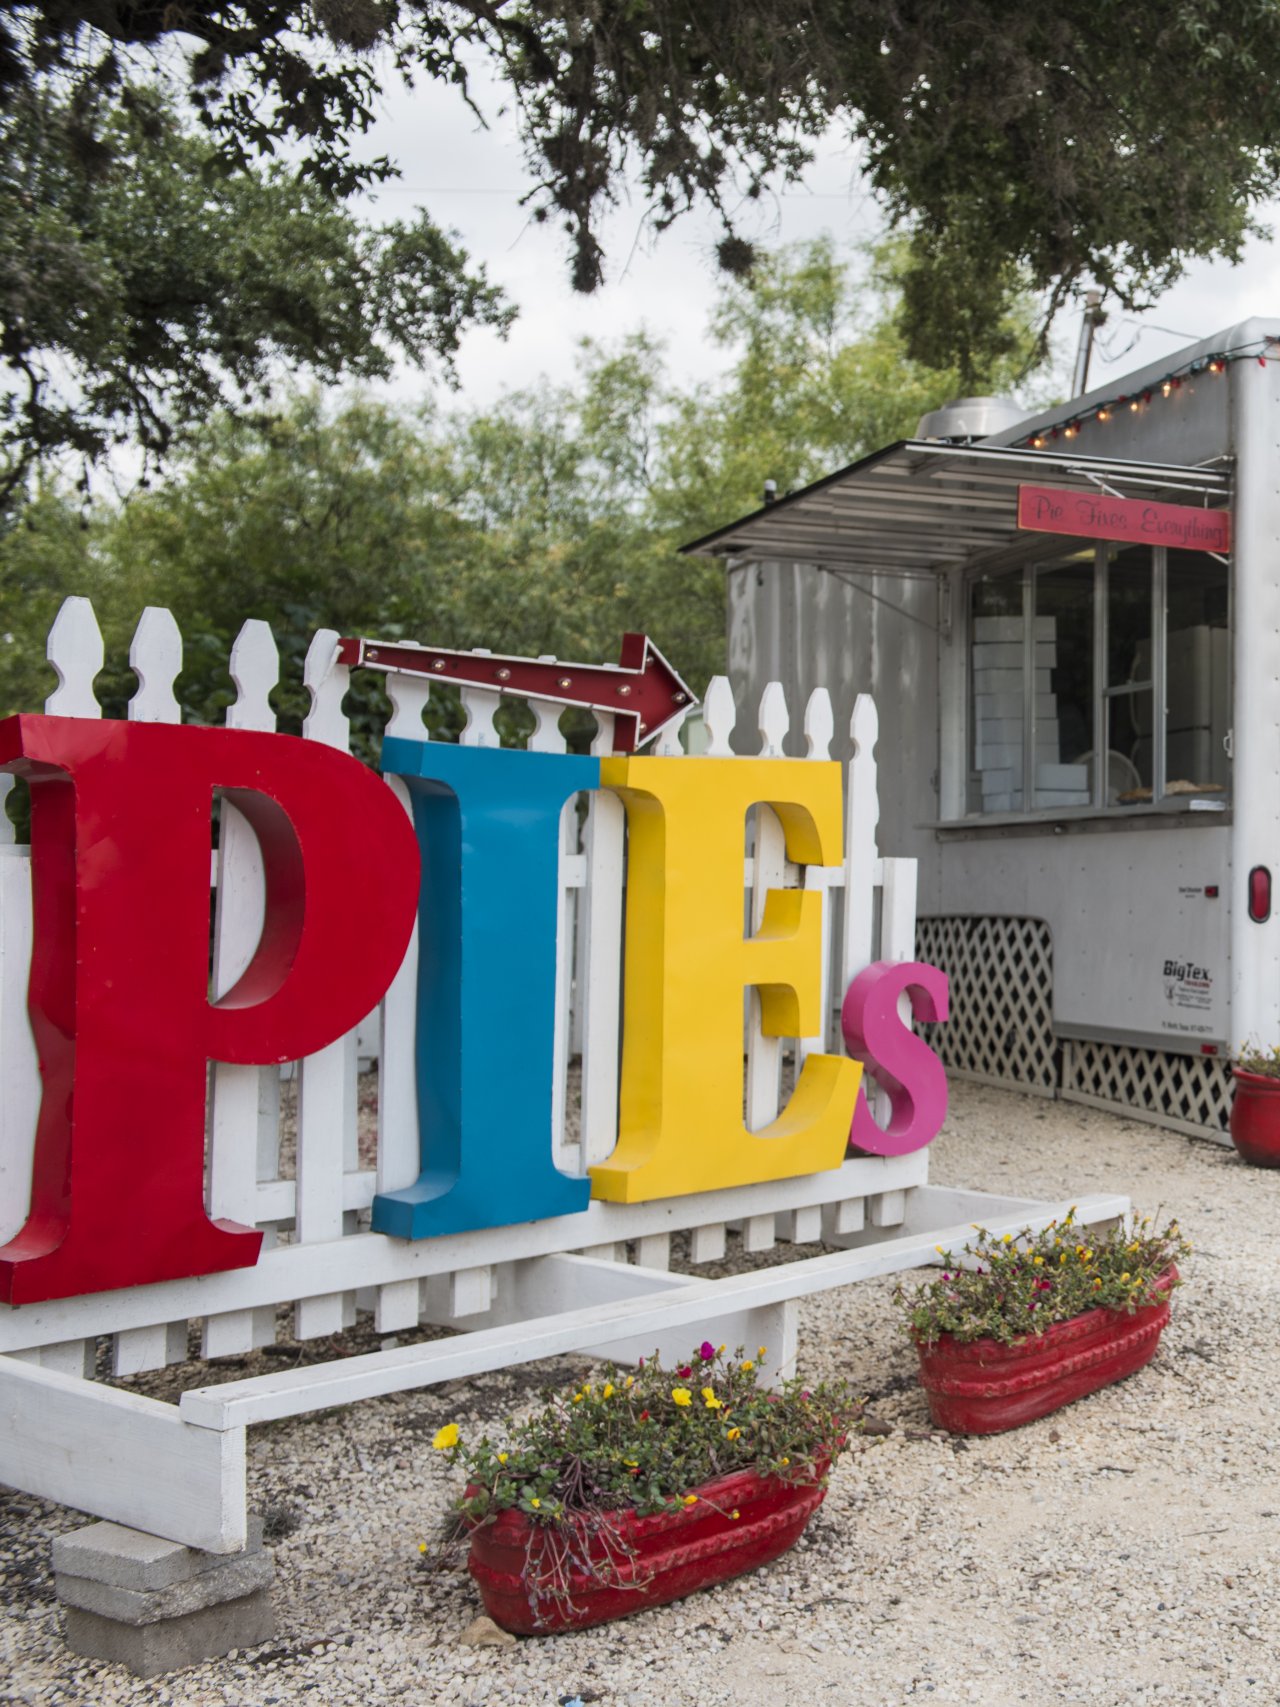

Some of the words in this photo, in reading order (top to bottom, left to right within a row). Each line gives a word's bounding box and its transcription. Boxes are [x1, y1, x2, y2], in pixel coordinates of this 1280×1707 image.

[1029, 495, 1063, 521] Pie
[1141, 508, 1225, 548] Everything
[1163, 960, 1210, 981] BigTex
